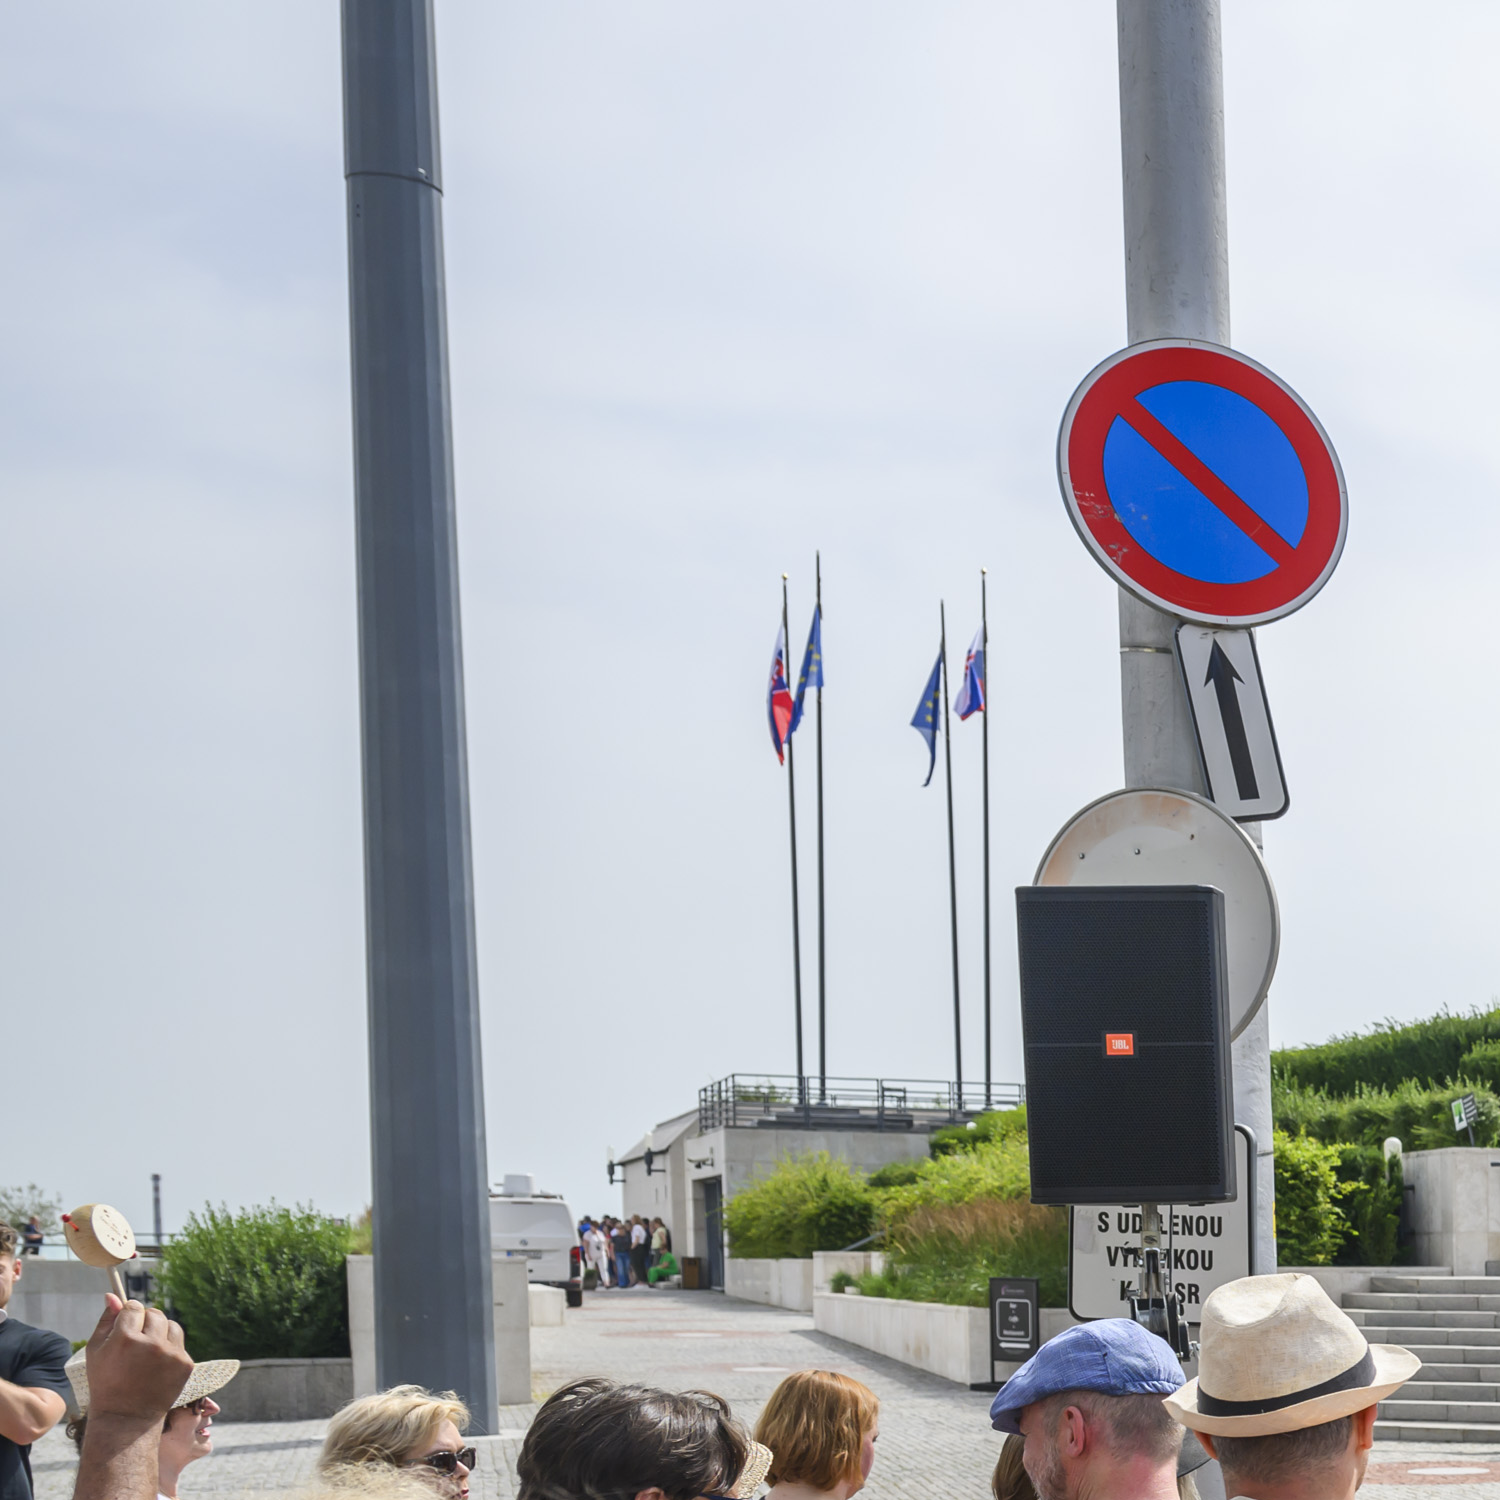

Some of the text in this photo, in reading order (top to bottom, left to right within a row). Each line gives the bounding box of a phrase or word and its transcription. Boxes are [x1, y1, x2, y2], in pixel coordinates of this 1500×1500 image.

[1111, 1039, 1129, 1050] JBL
[1097, 1211, 1222, 1237] S UDLENOU
[1174, 1282, 1200, 1304] SR
